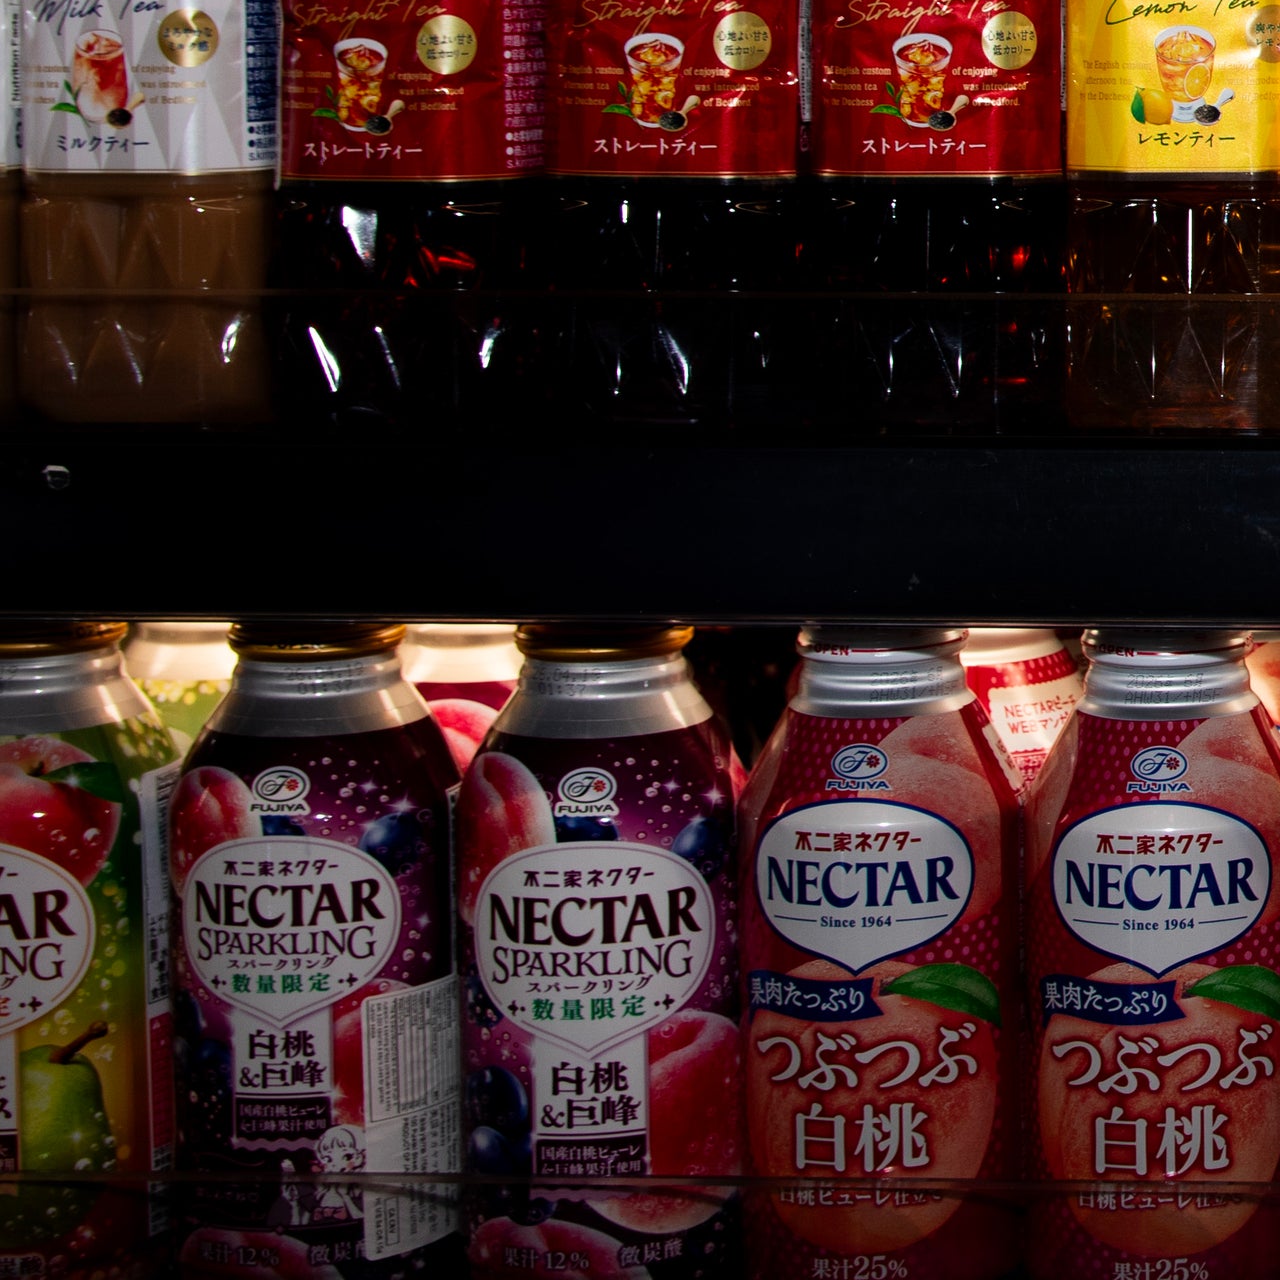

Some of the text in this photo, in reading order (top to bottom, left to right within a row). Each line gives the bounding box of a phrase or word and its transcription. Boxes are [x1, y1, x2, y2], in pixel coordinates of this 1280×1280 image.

[594, 137, 718, 155] ストレートティー
[862, 137, 987, 155] ストレートティー
[1138, 132, 1236, 148] レモンティー
[826, 779, 890, 791] FUJIYA
[1127, 781, 1191, 793] FUJIYA
[251, 802, 306, 814] FUJIYA
[558, 803, 616, 815] FUJIYA
[795, 830, 922, 851] 不二家ネクター
[1096, 832, 1223, 855] 不二家ネクター
[223, 860, 339, 878] 不二家ネクター
[524, 867, 654, 889] 不二家ネクター
[767, 854, 961, 909] NECTAR
[1064, 855, 1258, 912] NECTAR
[195, 876, 385, 928] NECTAR
[489, 885, 703, 946] NECTAR
[821, 915, 892, 928] Since 1964
[1122, 918, 1194, 931] Since 1964
[198, 925, 376, 961] SPARKLING
[493, 940, 693, 984] SPARKLING
[231, 972, 330, 995] 数量限定
[751, 977, 865, 1013] 果肉たっぷり
[531, 995, 647, 1021] 数量限定
[1044, 980, 1168, 1016] 果肉たっぷり
[249, 1029, 316, 1061] 白桃
[757, 1022, 978, 1091] つぶつぶ
[1052, 1025, 1273, 1093] つぶつぶ
[240, 1062, 326, 1089] &巨峰
[551, 1061, 628, 1096] 白桃
[541, 1094, 641, 1130] &巨峰
[795, 1104, 930, 1173] 白桃
[1095, 1106, 1229, 1177] 白桃
